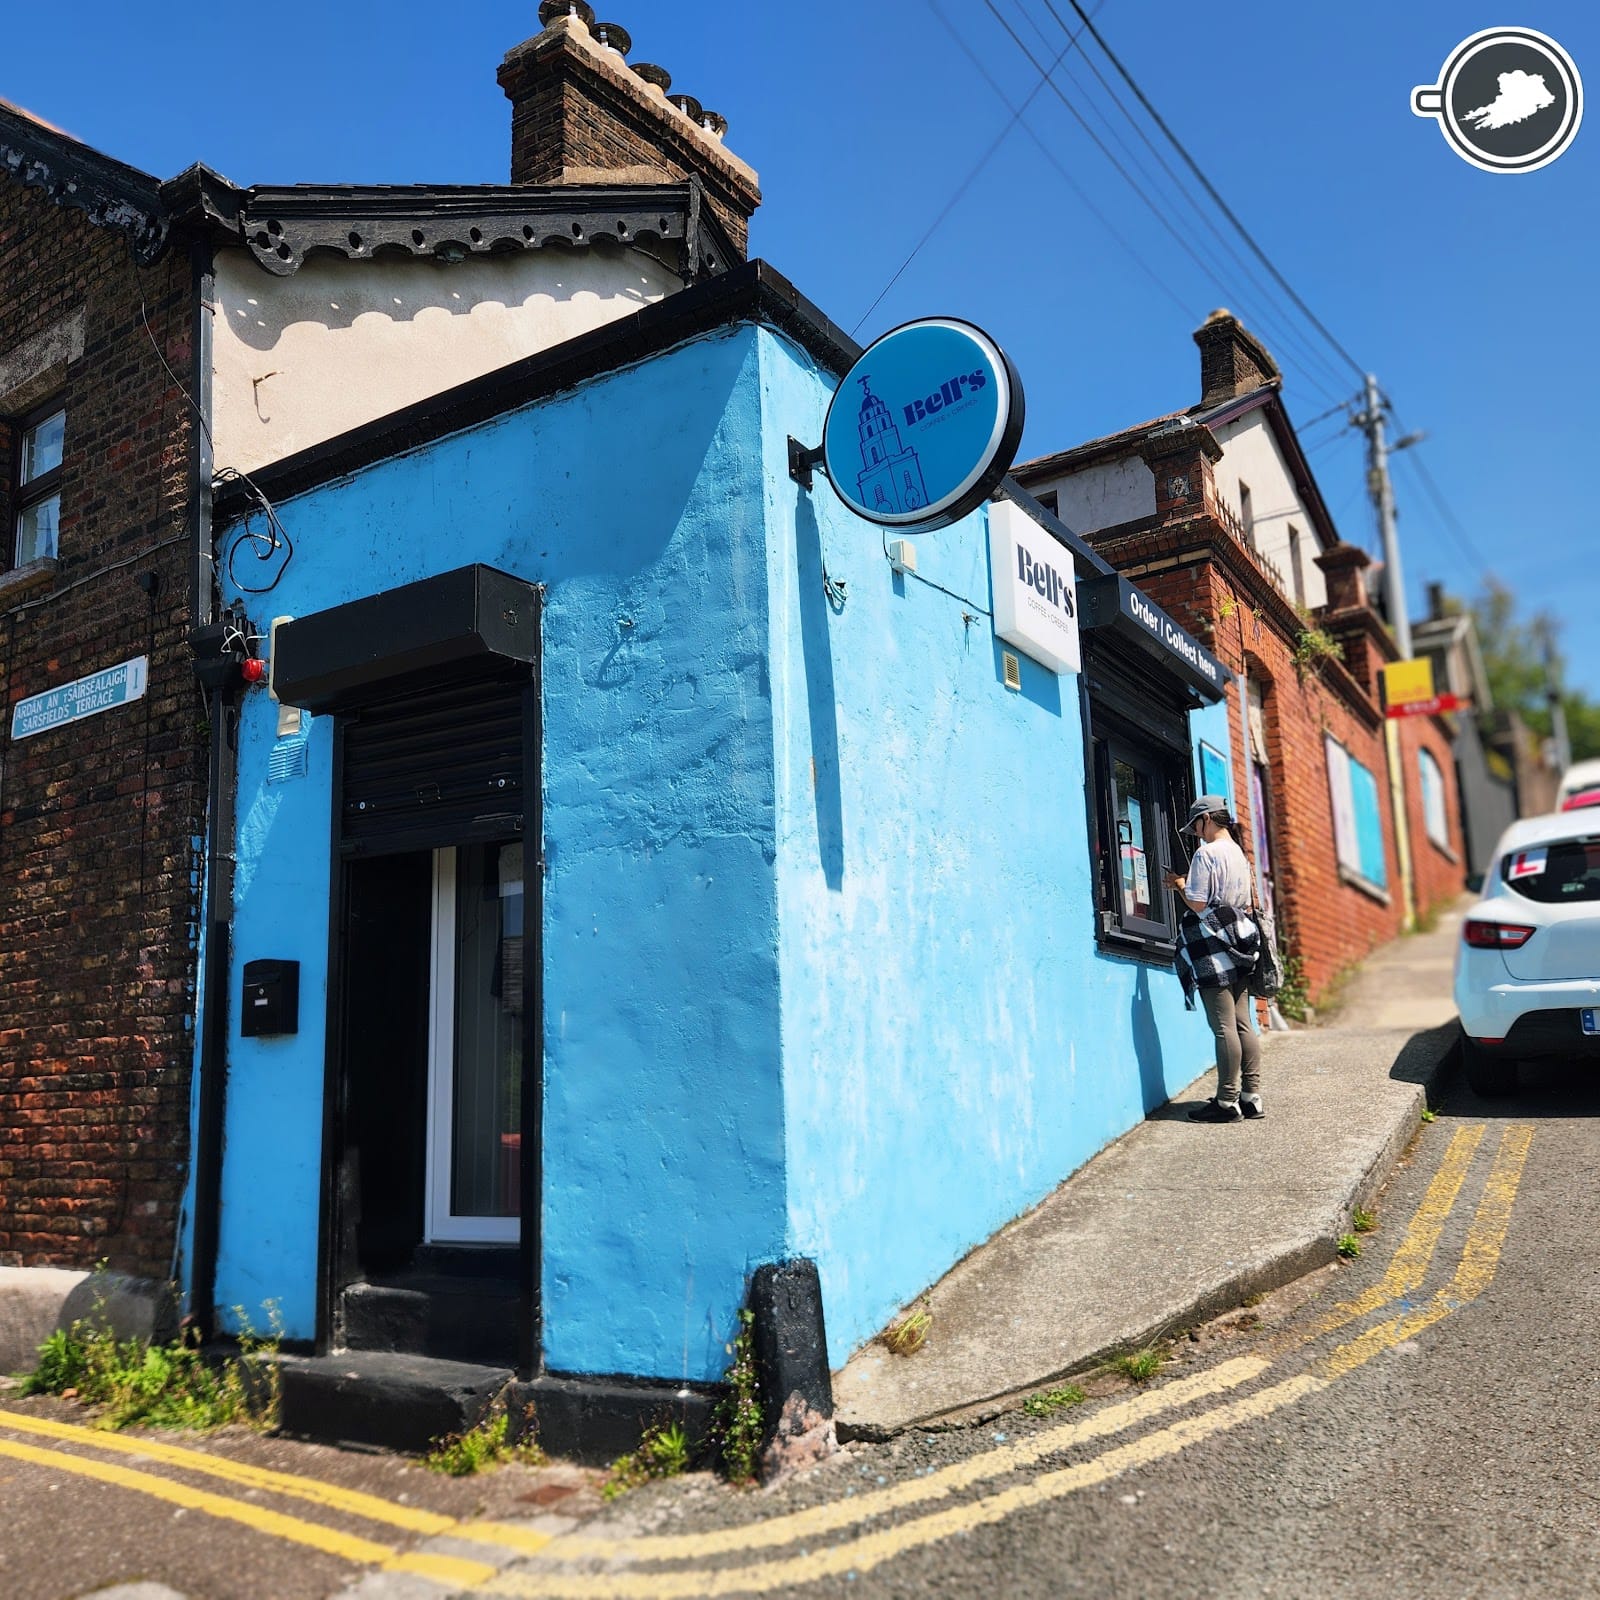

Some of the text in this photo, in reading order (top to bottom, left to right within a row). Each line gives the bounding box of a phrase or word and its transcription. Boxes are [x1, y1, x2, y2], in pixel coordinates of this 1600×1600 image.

[903, 369, 986, 427] Bell's
[1016, 543, 1074, 618] Bell's
[1130, 592, 1158, 632] Order
[1165, 623, 1197, 665] Collect
[1198, 649, 1216, 680] here
[22, 689, 114, 732] SARSFIELD'S TERRACE
[46, 693, 59, 710] AN
[1515, 852, 1538, 875] L
